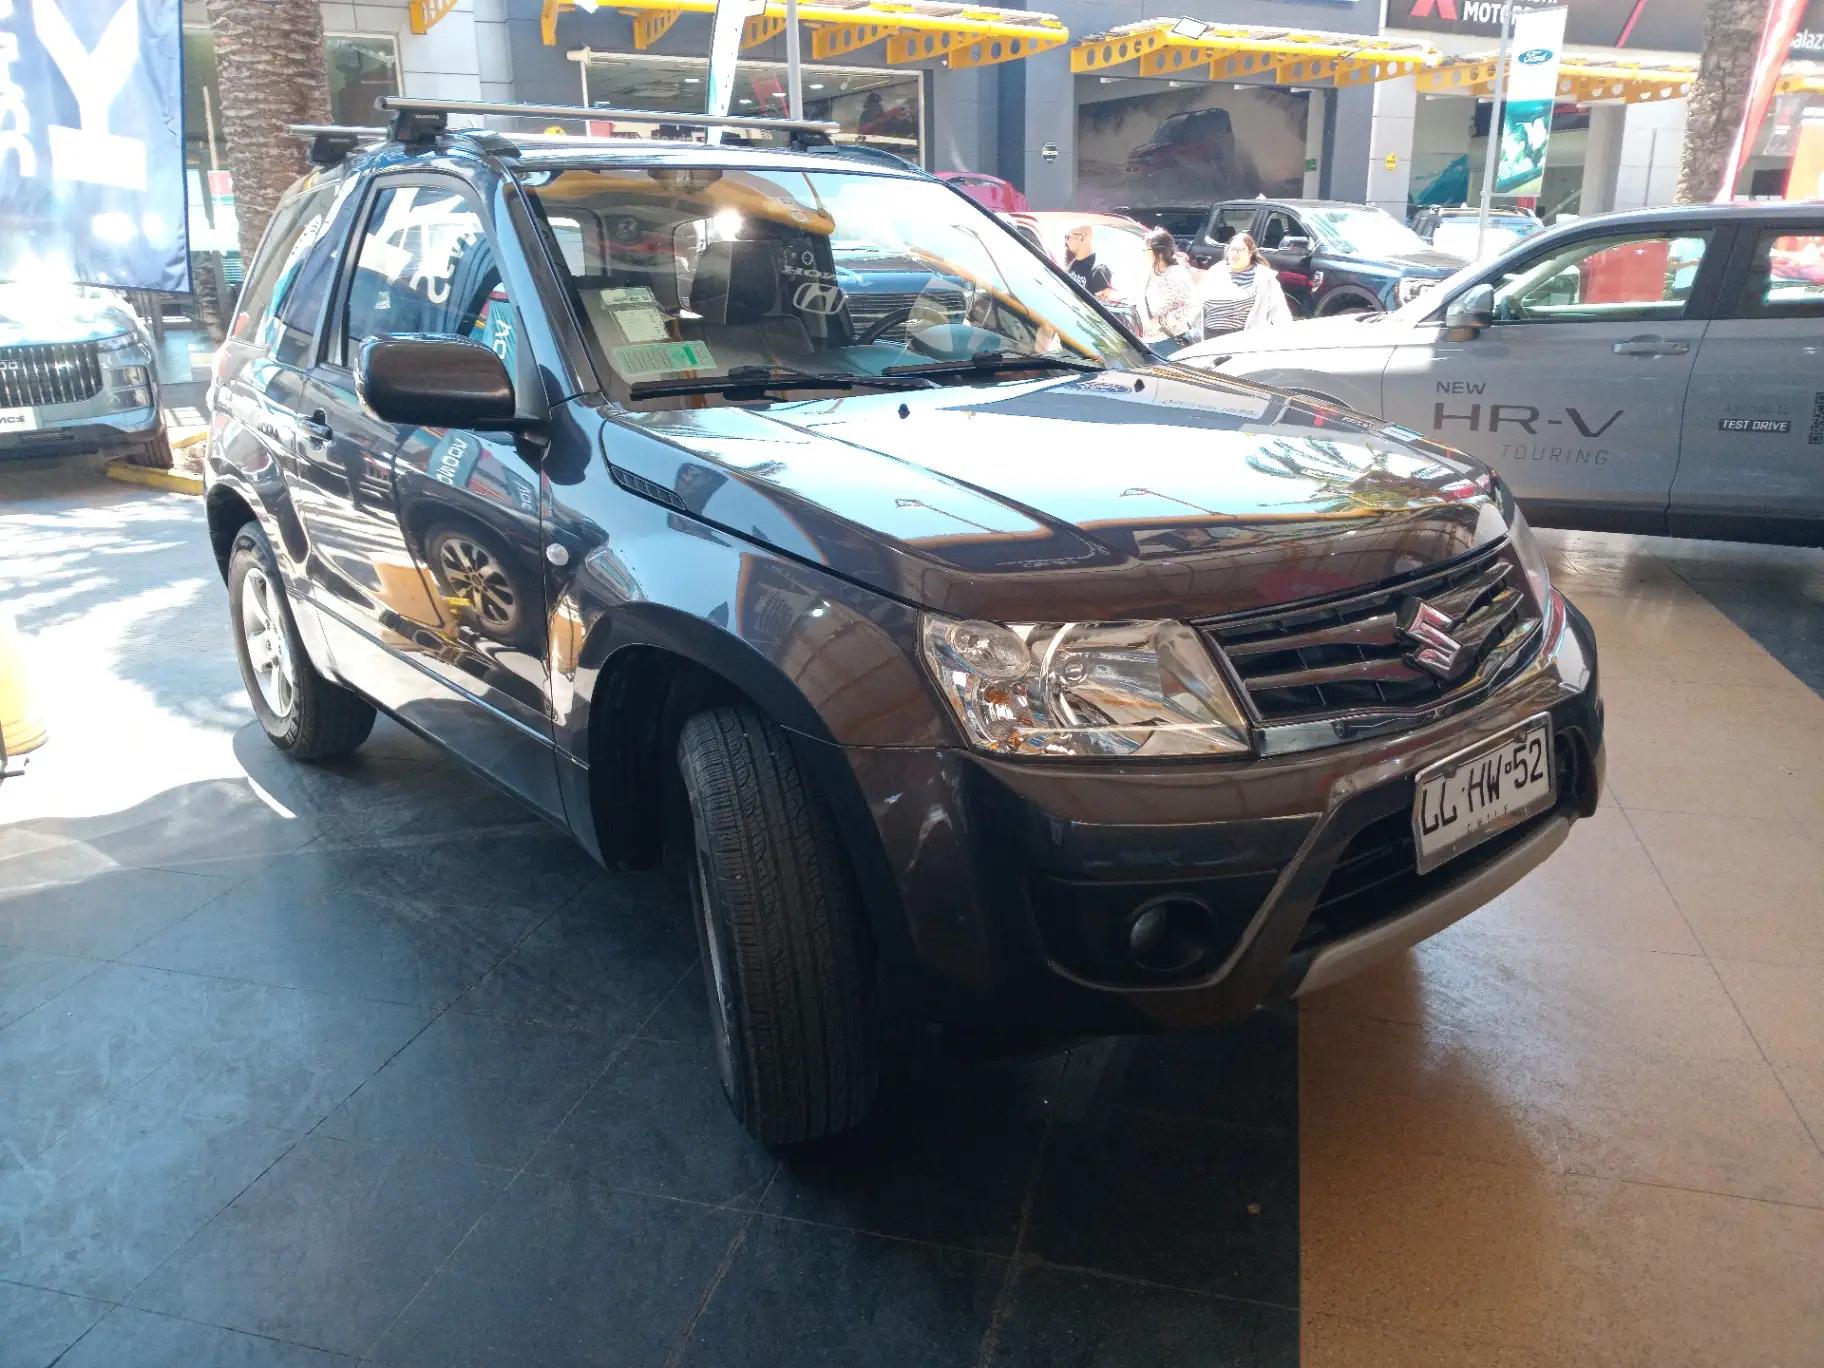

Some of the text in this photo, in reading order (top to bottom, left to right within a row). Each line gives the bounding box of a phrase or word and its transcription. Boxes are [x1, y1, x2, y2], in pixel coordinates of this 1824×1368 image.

[1463, 0, 1536, 25] MOTOR
[1522, 50, 1550, 63] Ford
[1436, 381, 1486, 395] NEW
[1433, 402, 1624, 438] HR-V
[1722, 420, 1788, 432] TEST DRIVE
[1501, 442, 1611, 466] TOURING
